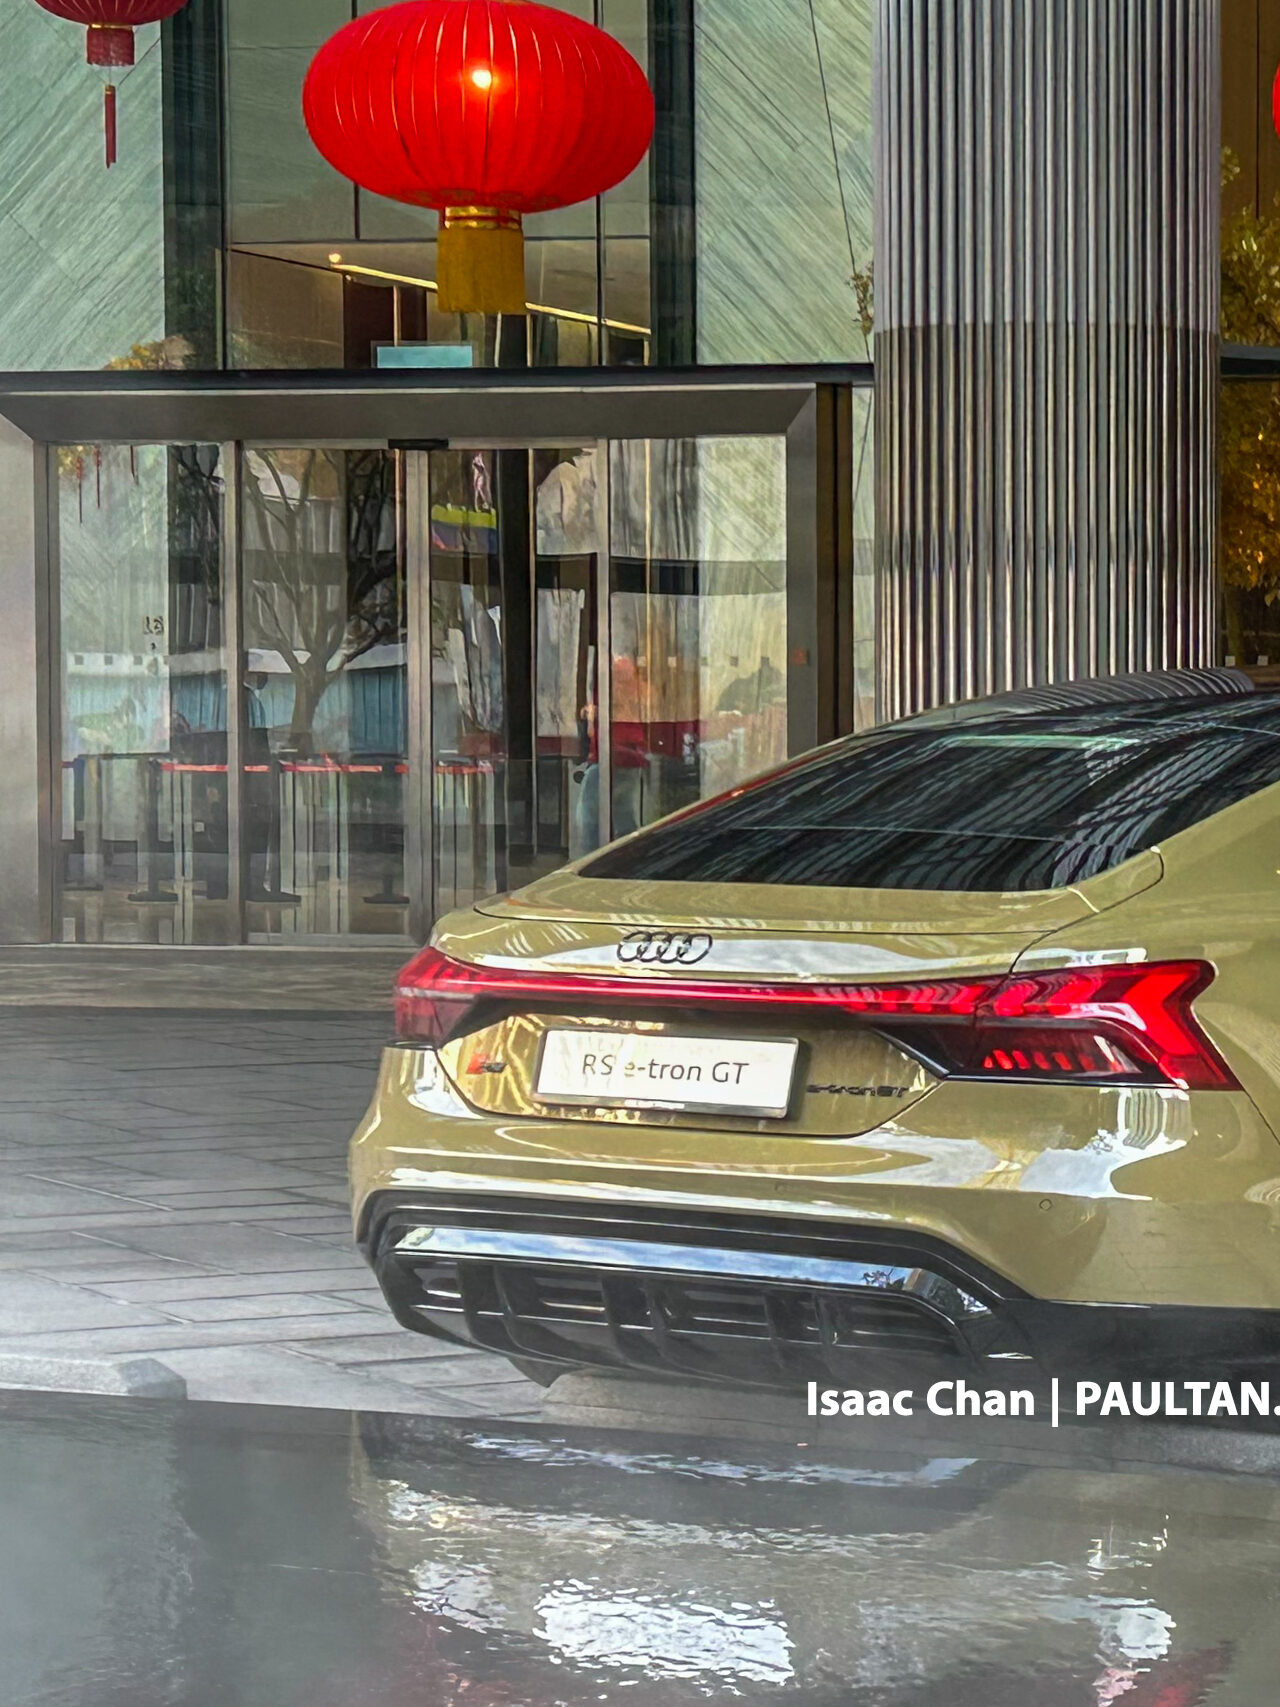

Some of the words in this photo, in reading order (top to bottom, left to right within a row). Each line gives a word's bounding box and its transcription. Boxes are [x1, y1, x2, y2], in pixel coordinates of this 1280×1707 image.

[582, 1053, 614, 1076] RS
[624, 1058, 703, 1082] e-tron
[712, 1061, 750, 1085] GT
